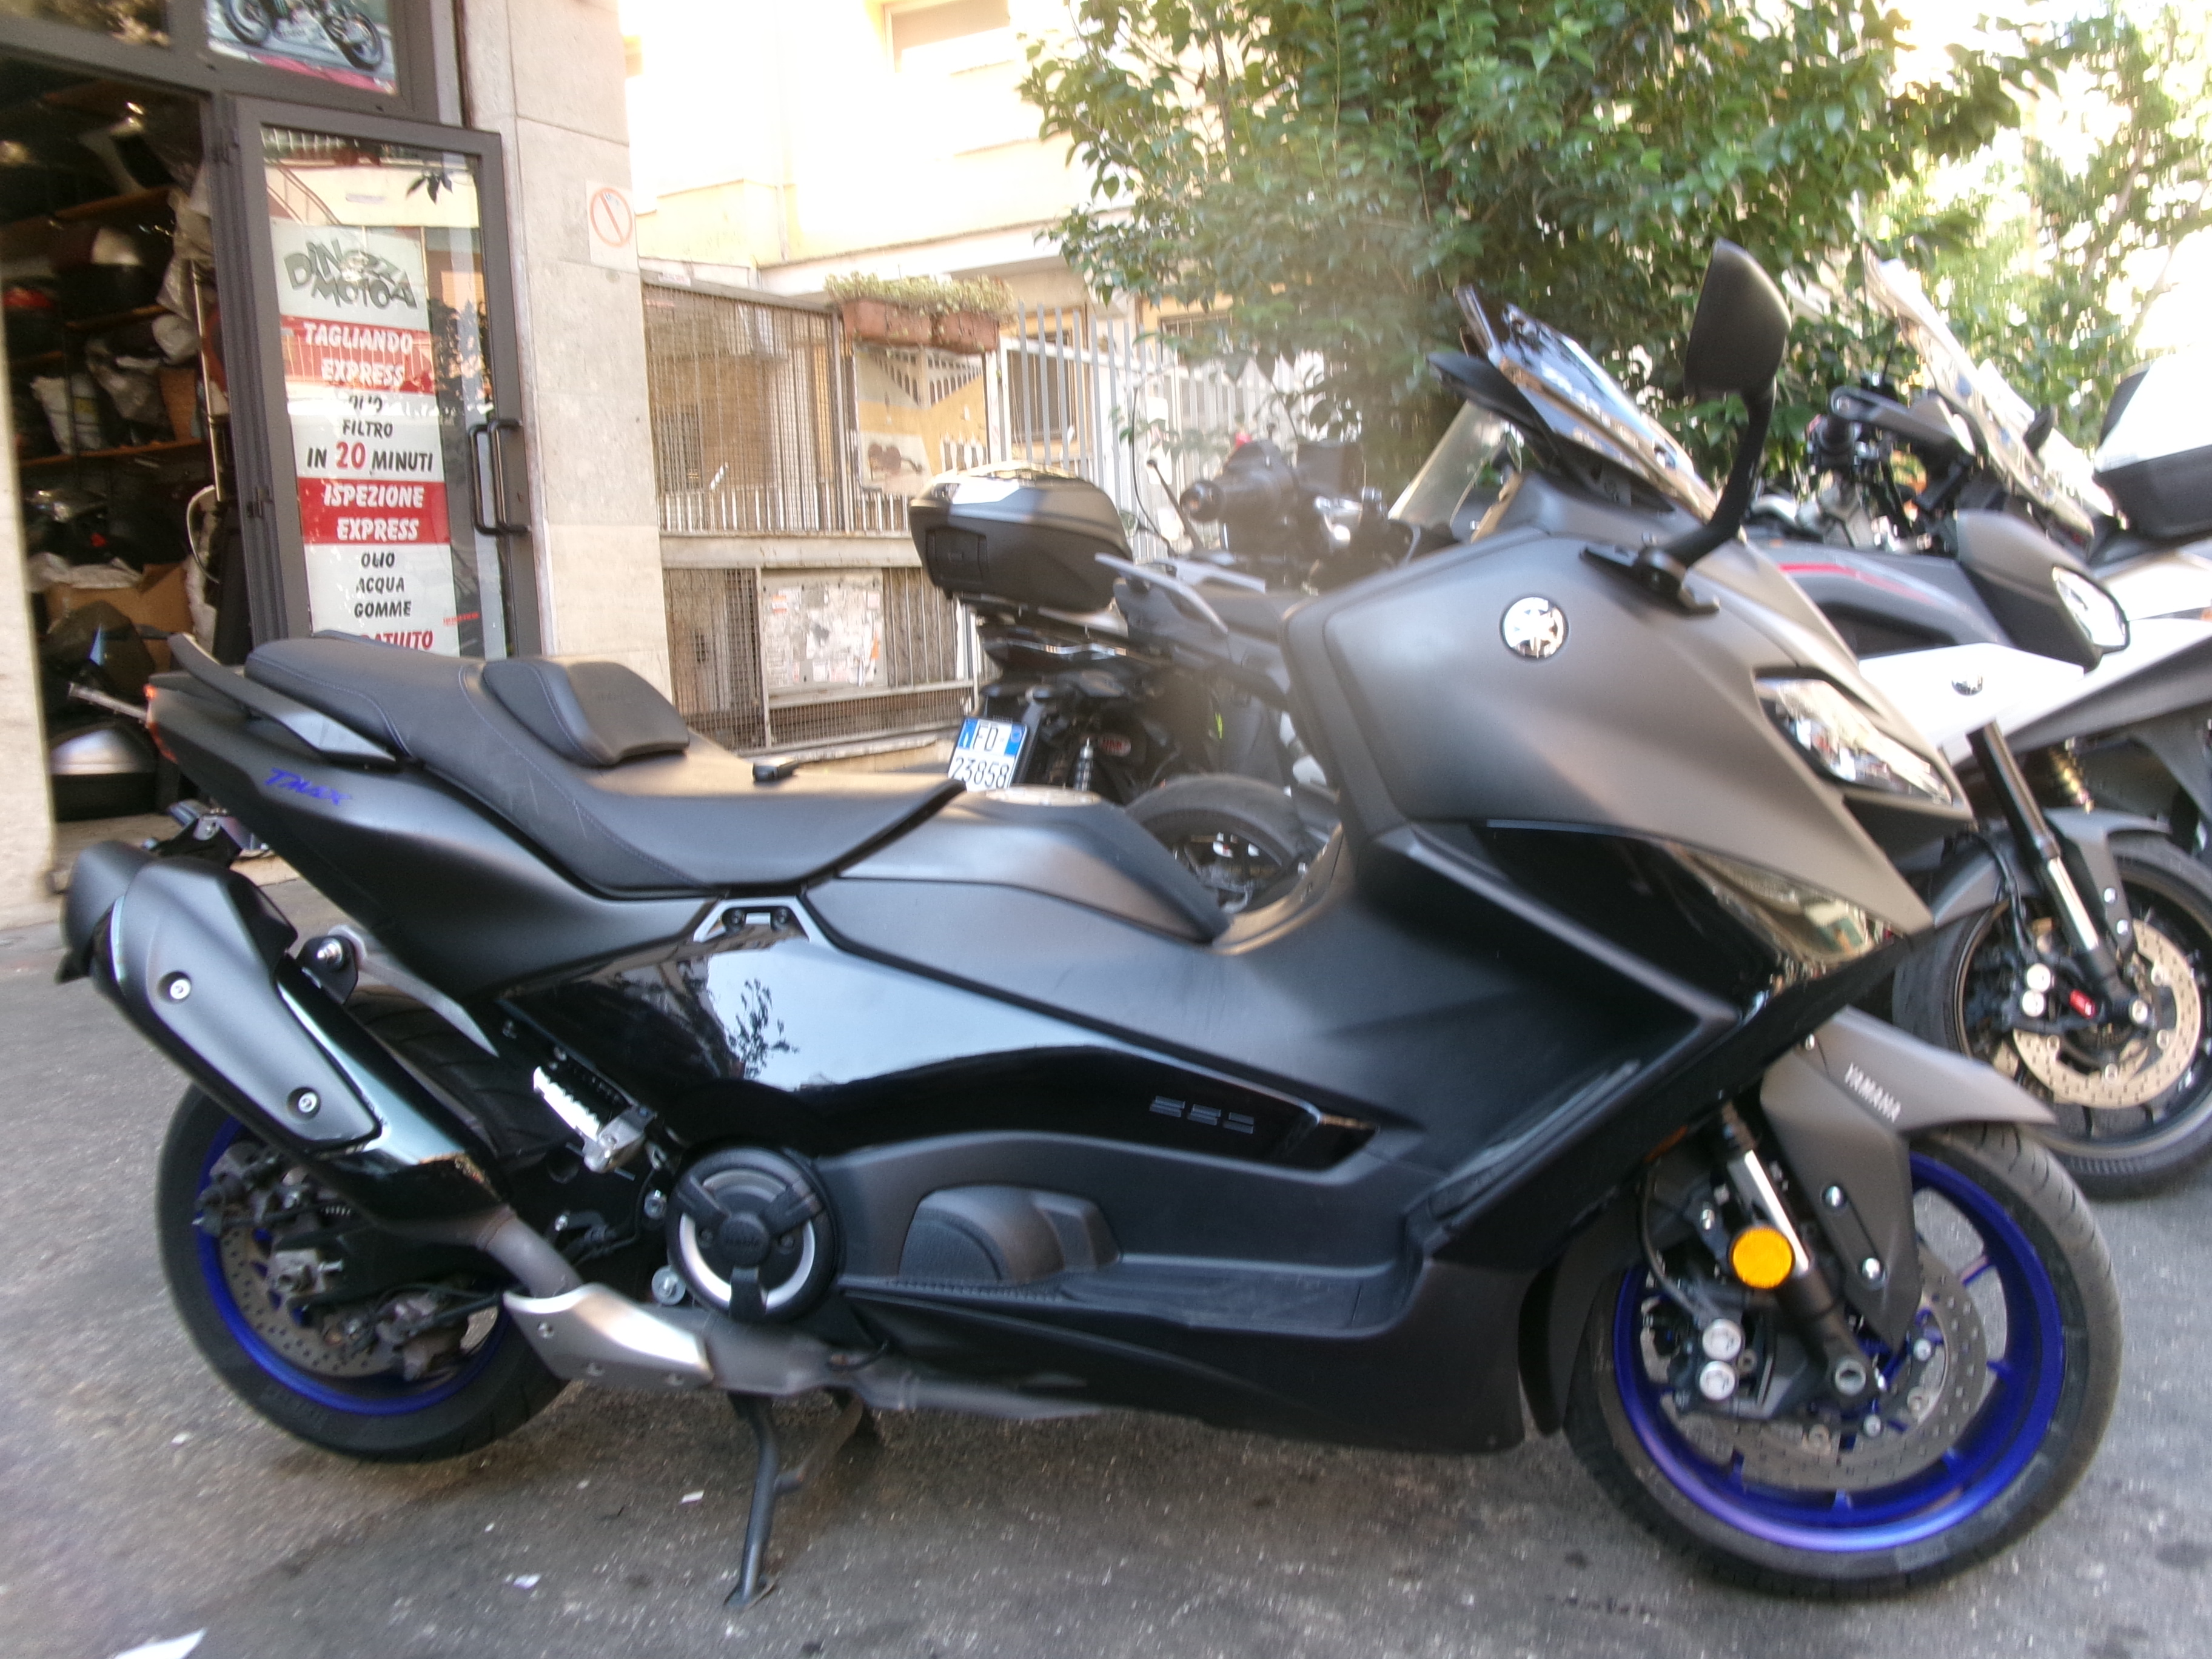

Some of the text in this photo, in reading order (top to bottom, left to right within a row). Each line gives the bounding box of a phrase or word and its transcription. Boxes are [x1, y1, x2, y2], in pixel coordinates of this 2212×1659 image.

[304, 323, 413, 355] TAGLIANDO
[320, 358, 406, 387] EXPRESS
[343, 418, 393, 438] FILTRO
[307, 441, 433, 471] IN 20 MINUTI
[324, 483, 425, 509] ISPEZIONE
[337, 517, 420, 542] EXPRESS
[361, 552, 395, 568] OLIO
[356, 577, 405, 594] ACQUA
[354, 600, 412, 618] GOMME
[951, 756, 1010, 789] 23858
[1844, 1061, 1902, 1123] YAMAHA
